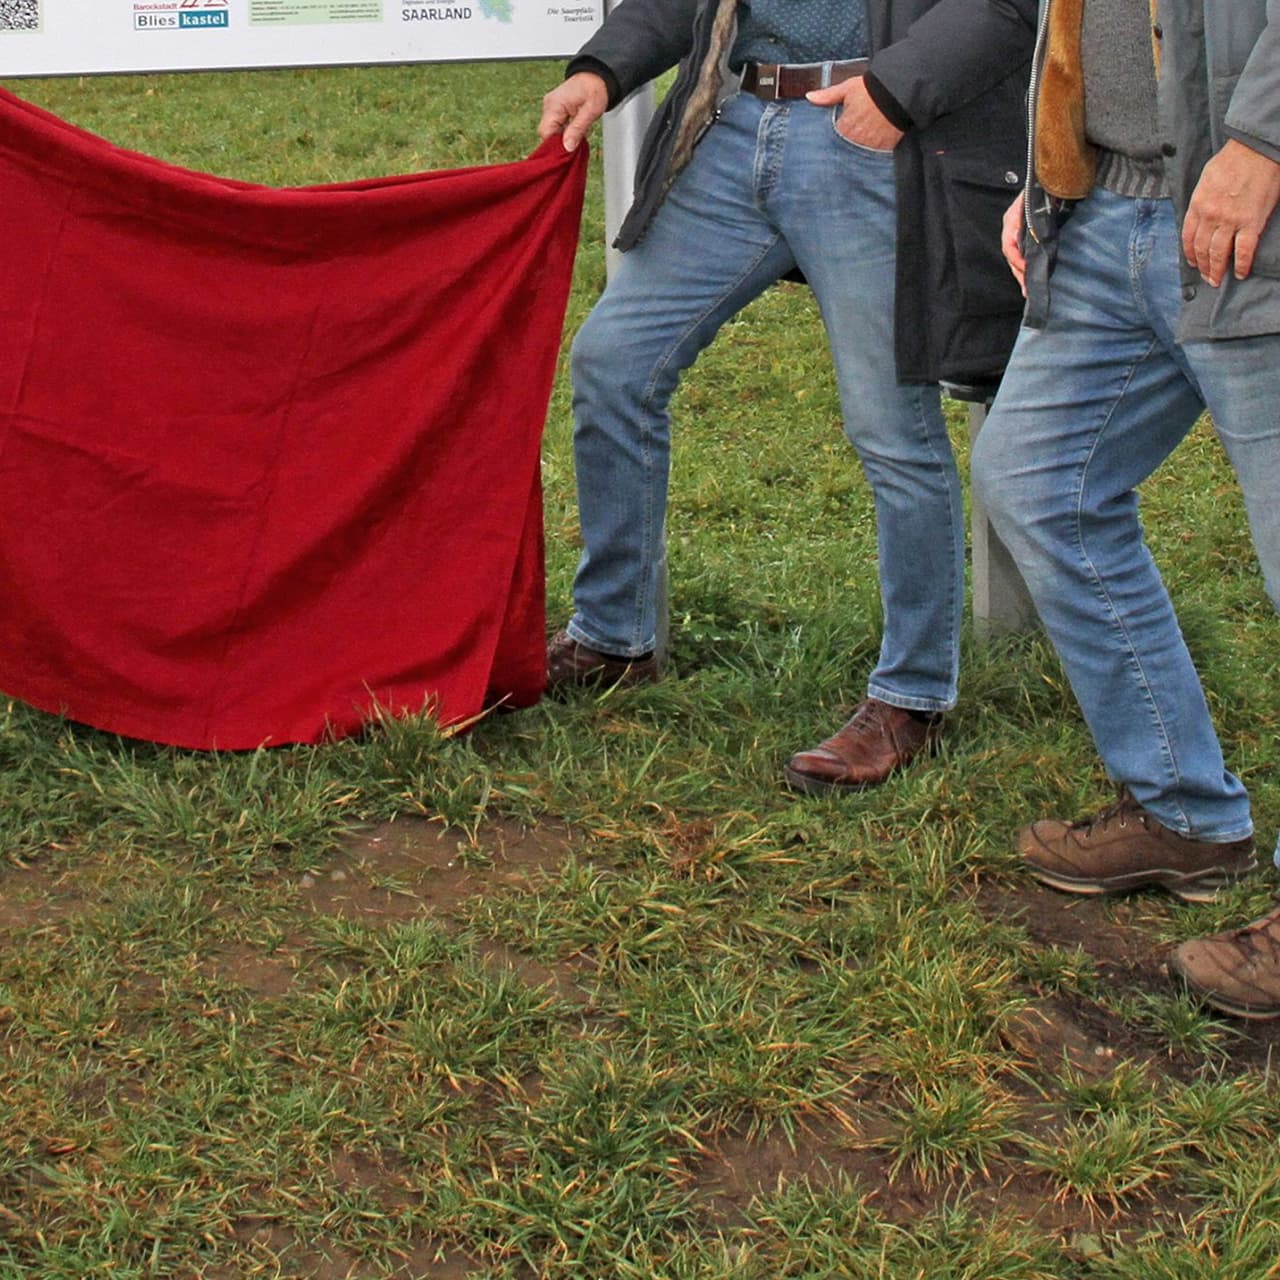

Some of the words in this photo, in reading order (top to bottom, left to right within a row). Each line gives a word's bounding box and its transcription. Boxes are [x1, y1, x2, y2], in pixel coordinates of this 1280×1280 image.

[138, 14, 177, 27] Blies
[182, 12, 226, 26] kastel
[402, 7, 472, 22] SAARLAND
